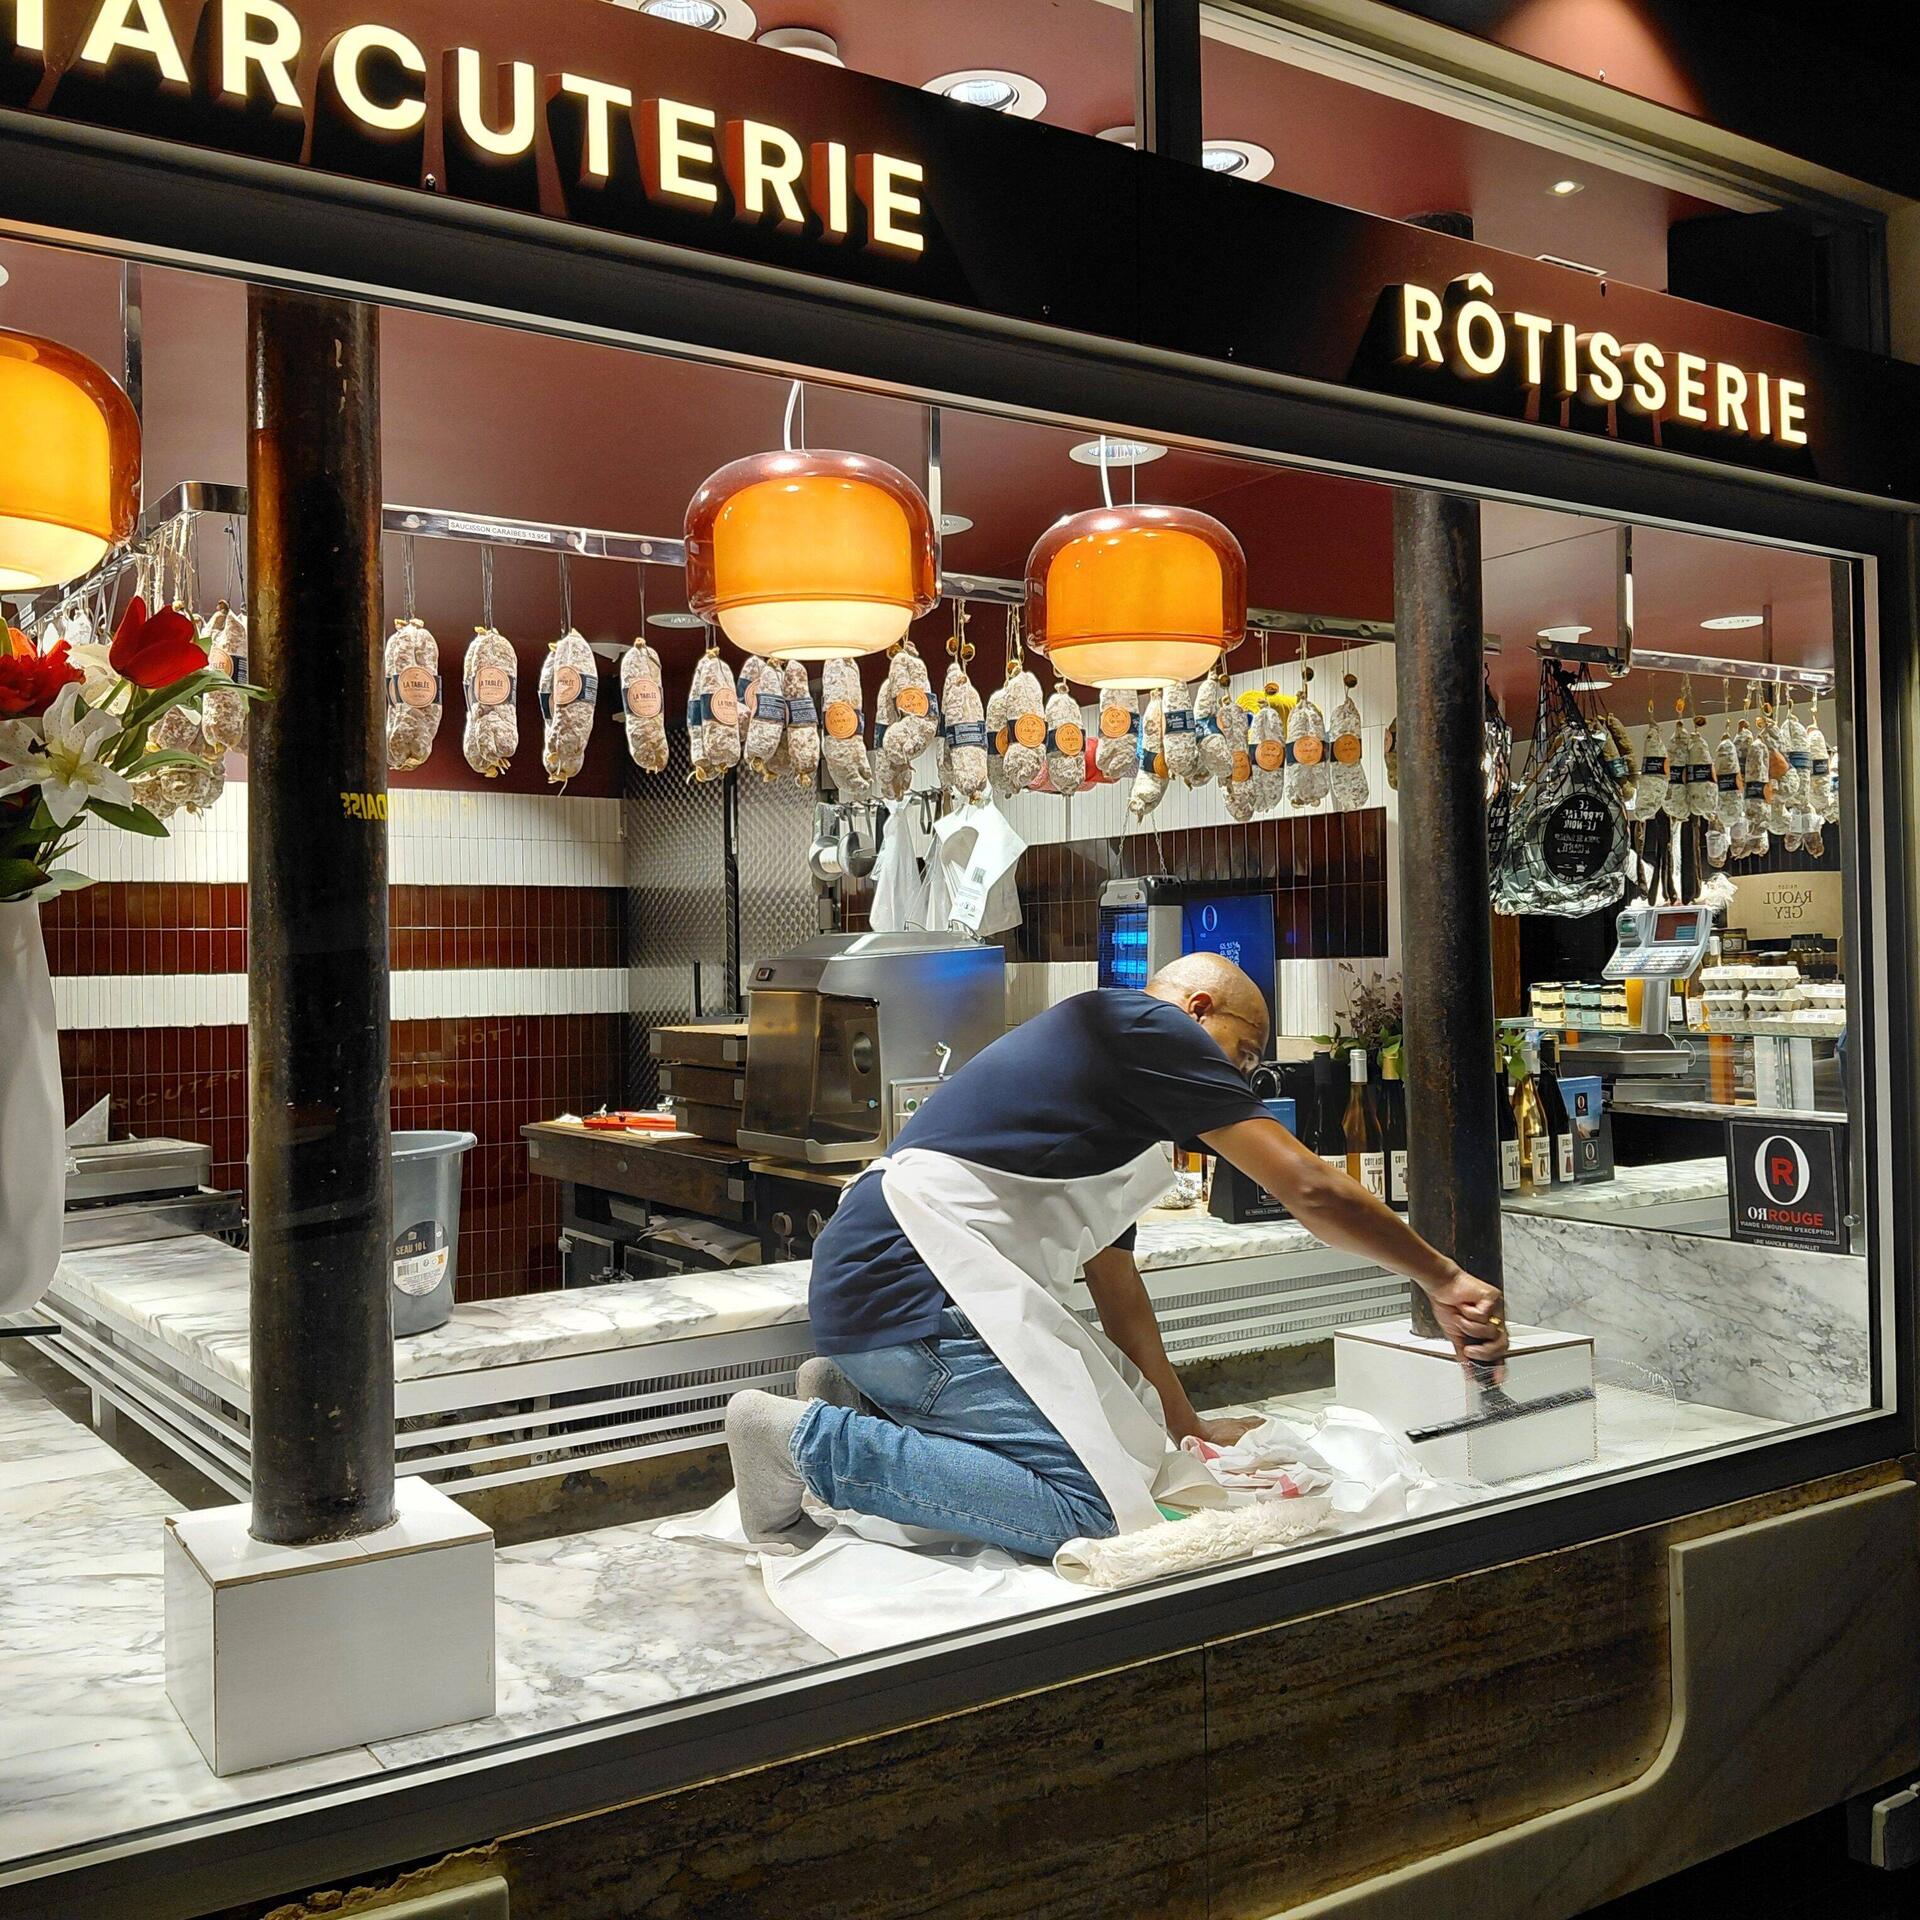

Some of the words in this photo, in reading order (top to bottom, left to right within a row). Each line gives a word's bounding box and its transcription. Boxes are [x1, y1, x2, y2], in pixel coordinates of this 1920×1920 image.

[14, 0, 926, 253] ARCUTERIE
[1403, 271, 1808, 445] RÔTISSERIE
[450, 521, 491, 534] SAUCISSON
[402, 681, 411, 689] LA
[1740, 1220, 1760, 1228] VIANDE
[1761, 1223, 1793, 1233] LIMOUSINE
[1794, 1226, 1835, 1236] D'EXCEPTION
[395, 1243, 413, 1256] SEAU
[415, 1241, 422, 1252] 10
[1765, 1239, 1787, 1248] MARQUE
